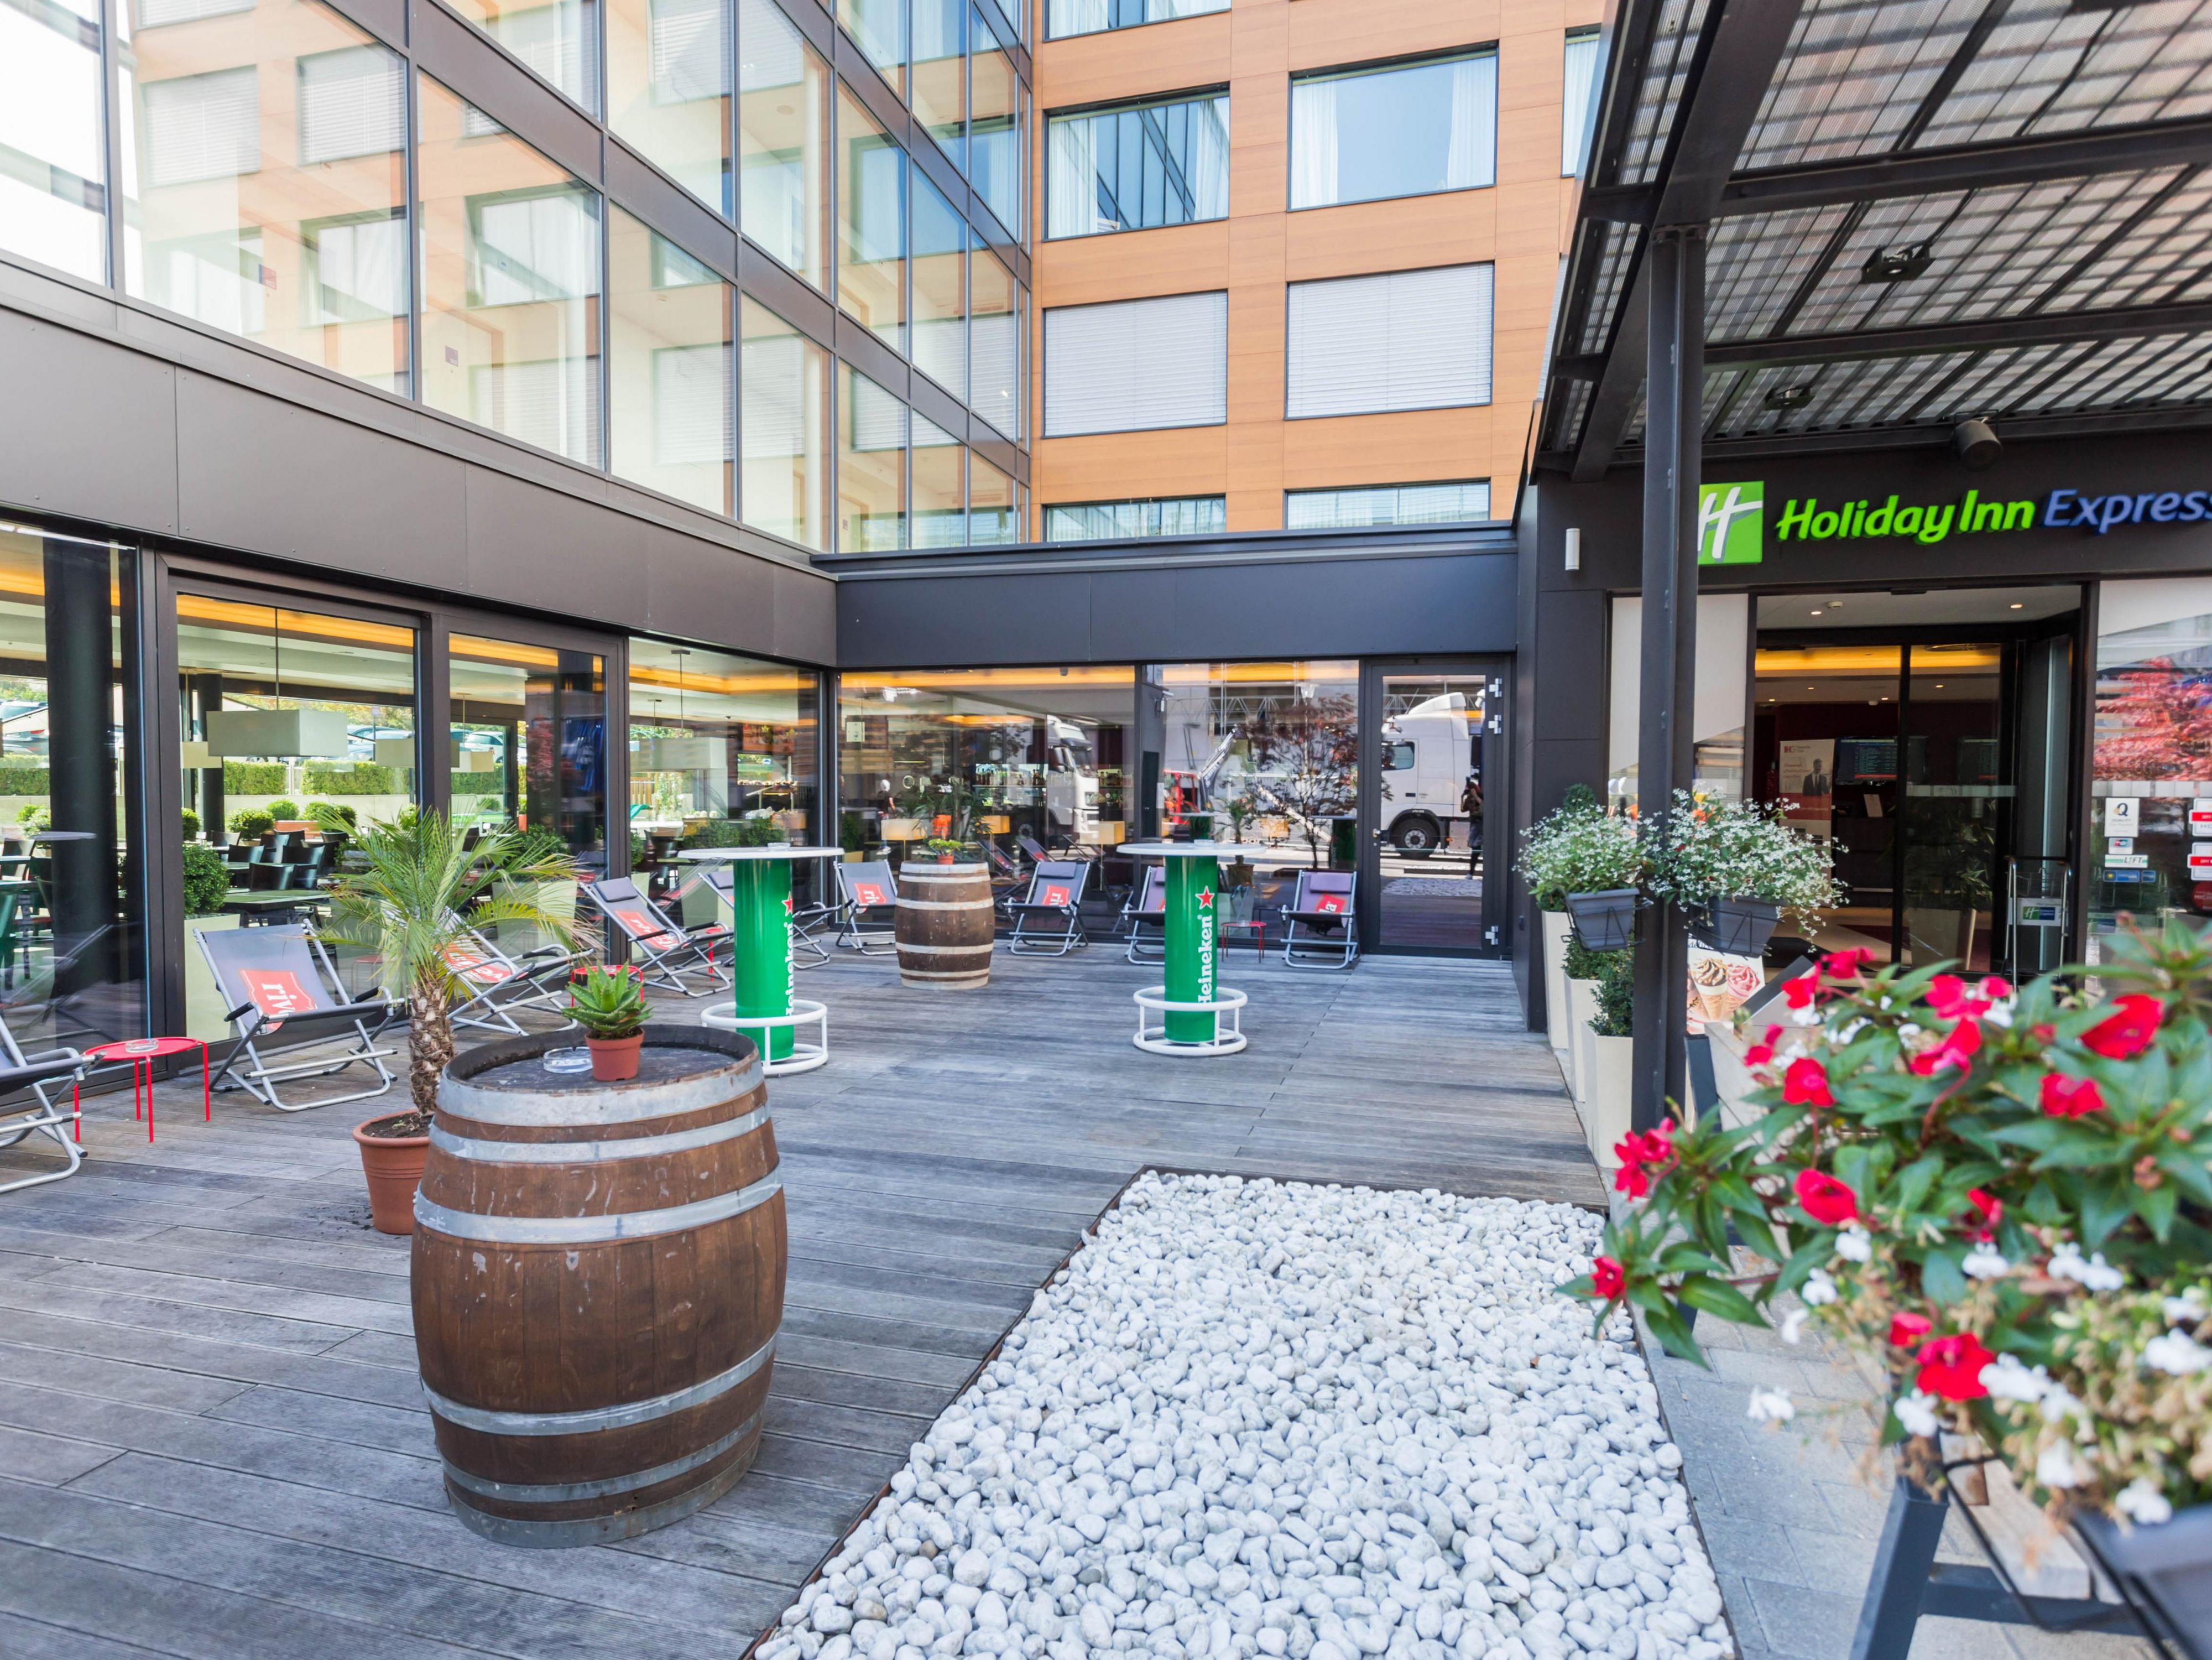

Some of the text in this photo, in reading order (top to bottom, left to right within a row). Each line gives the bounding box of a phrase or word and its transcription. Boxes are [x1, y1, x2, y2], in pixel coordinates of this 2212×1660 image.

[1775, 489, 1954, 544] Holiday
[1960, 490, 2035, 531] Inn
[2043, 488, 2212, 534] Expres
[1198, 915, 1212, 1005] Heineken
